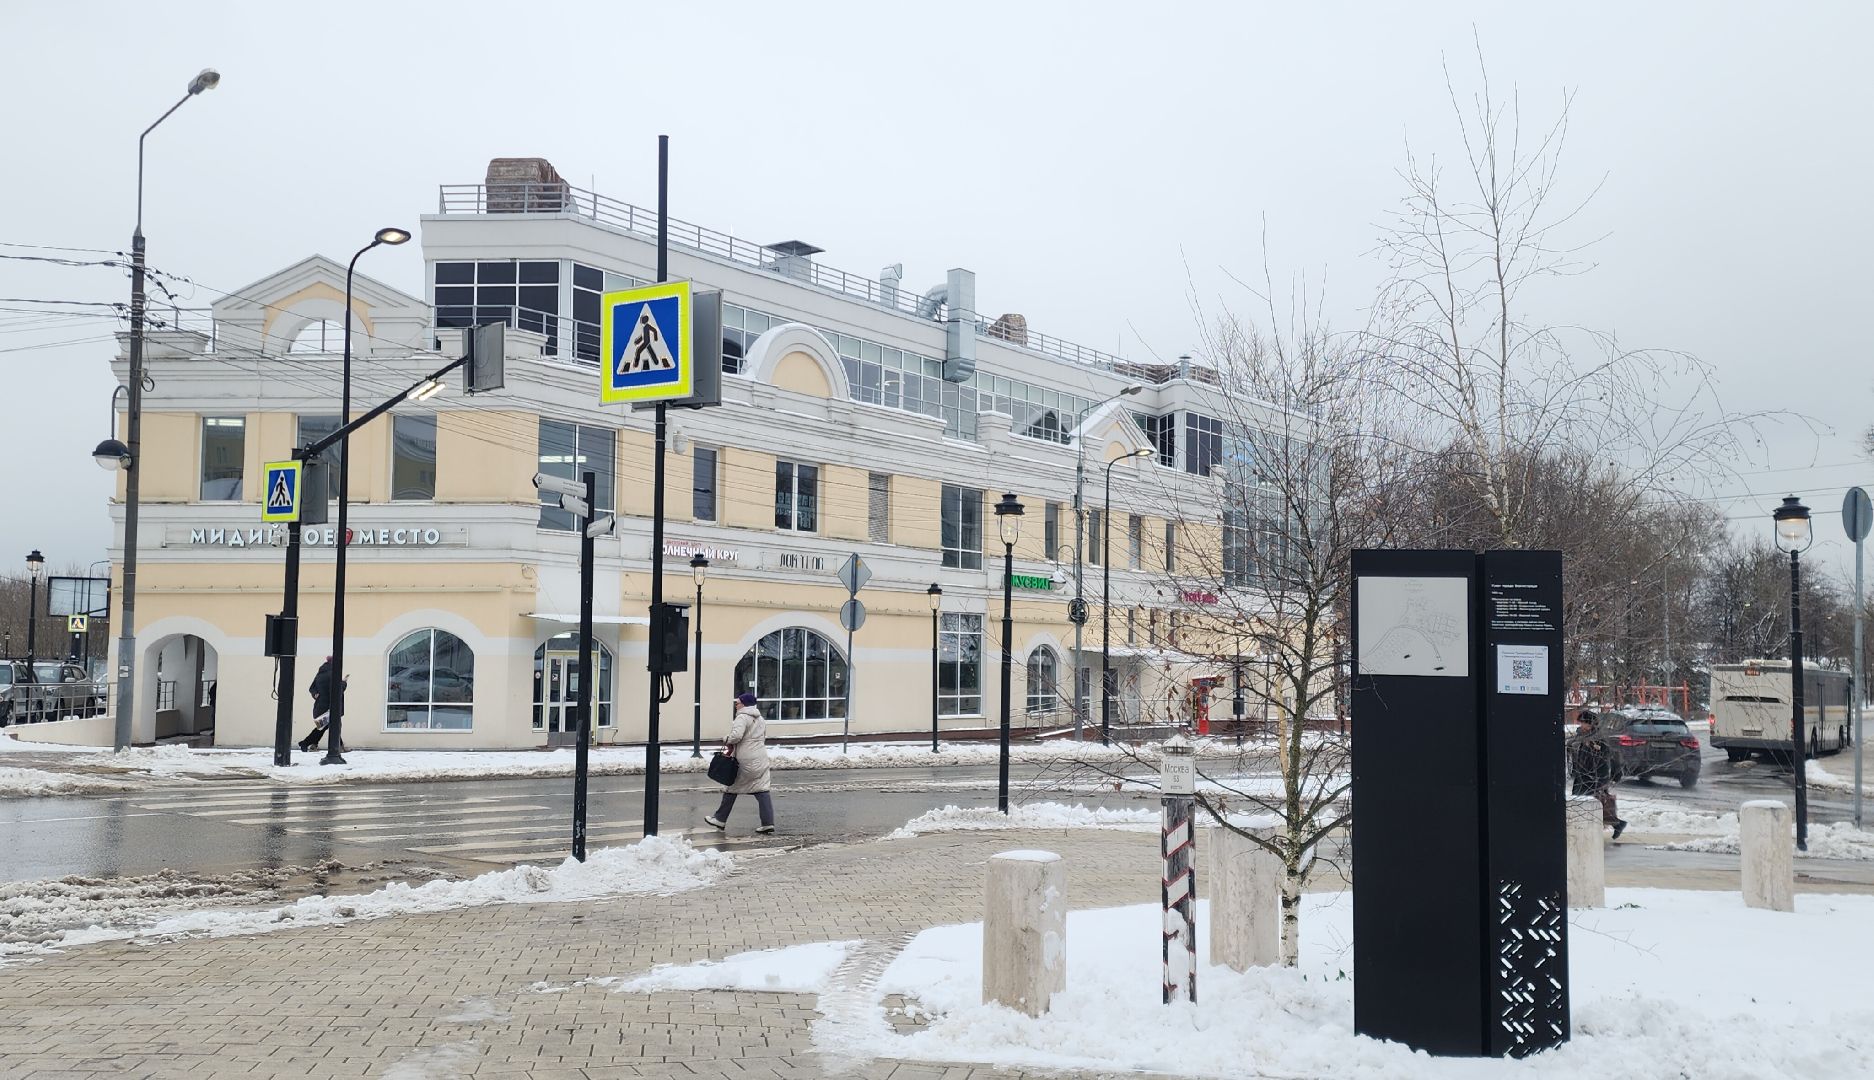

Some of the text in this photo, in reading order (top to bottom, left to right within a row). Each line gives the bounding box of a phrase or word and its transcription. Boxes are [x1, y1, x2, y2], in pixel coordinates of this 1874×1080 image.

[190, 524, 441, 547] МИДИЙОЕ МЕСТО
[652, 545, 739, 561] ОЛНЕЧНЫЙ КРУГ
